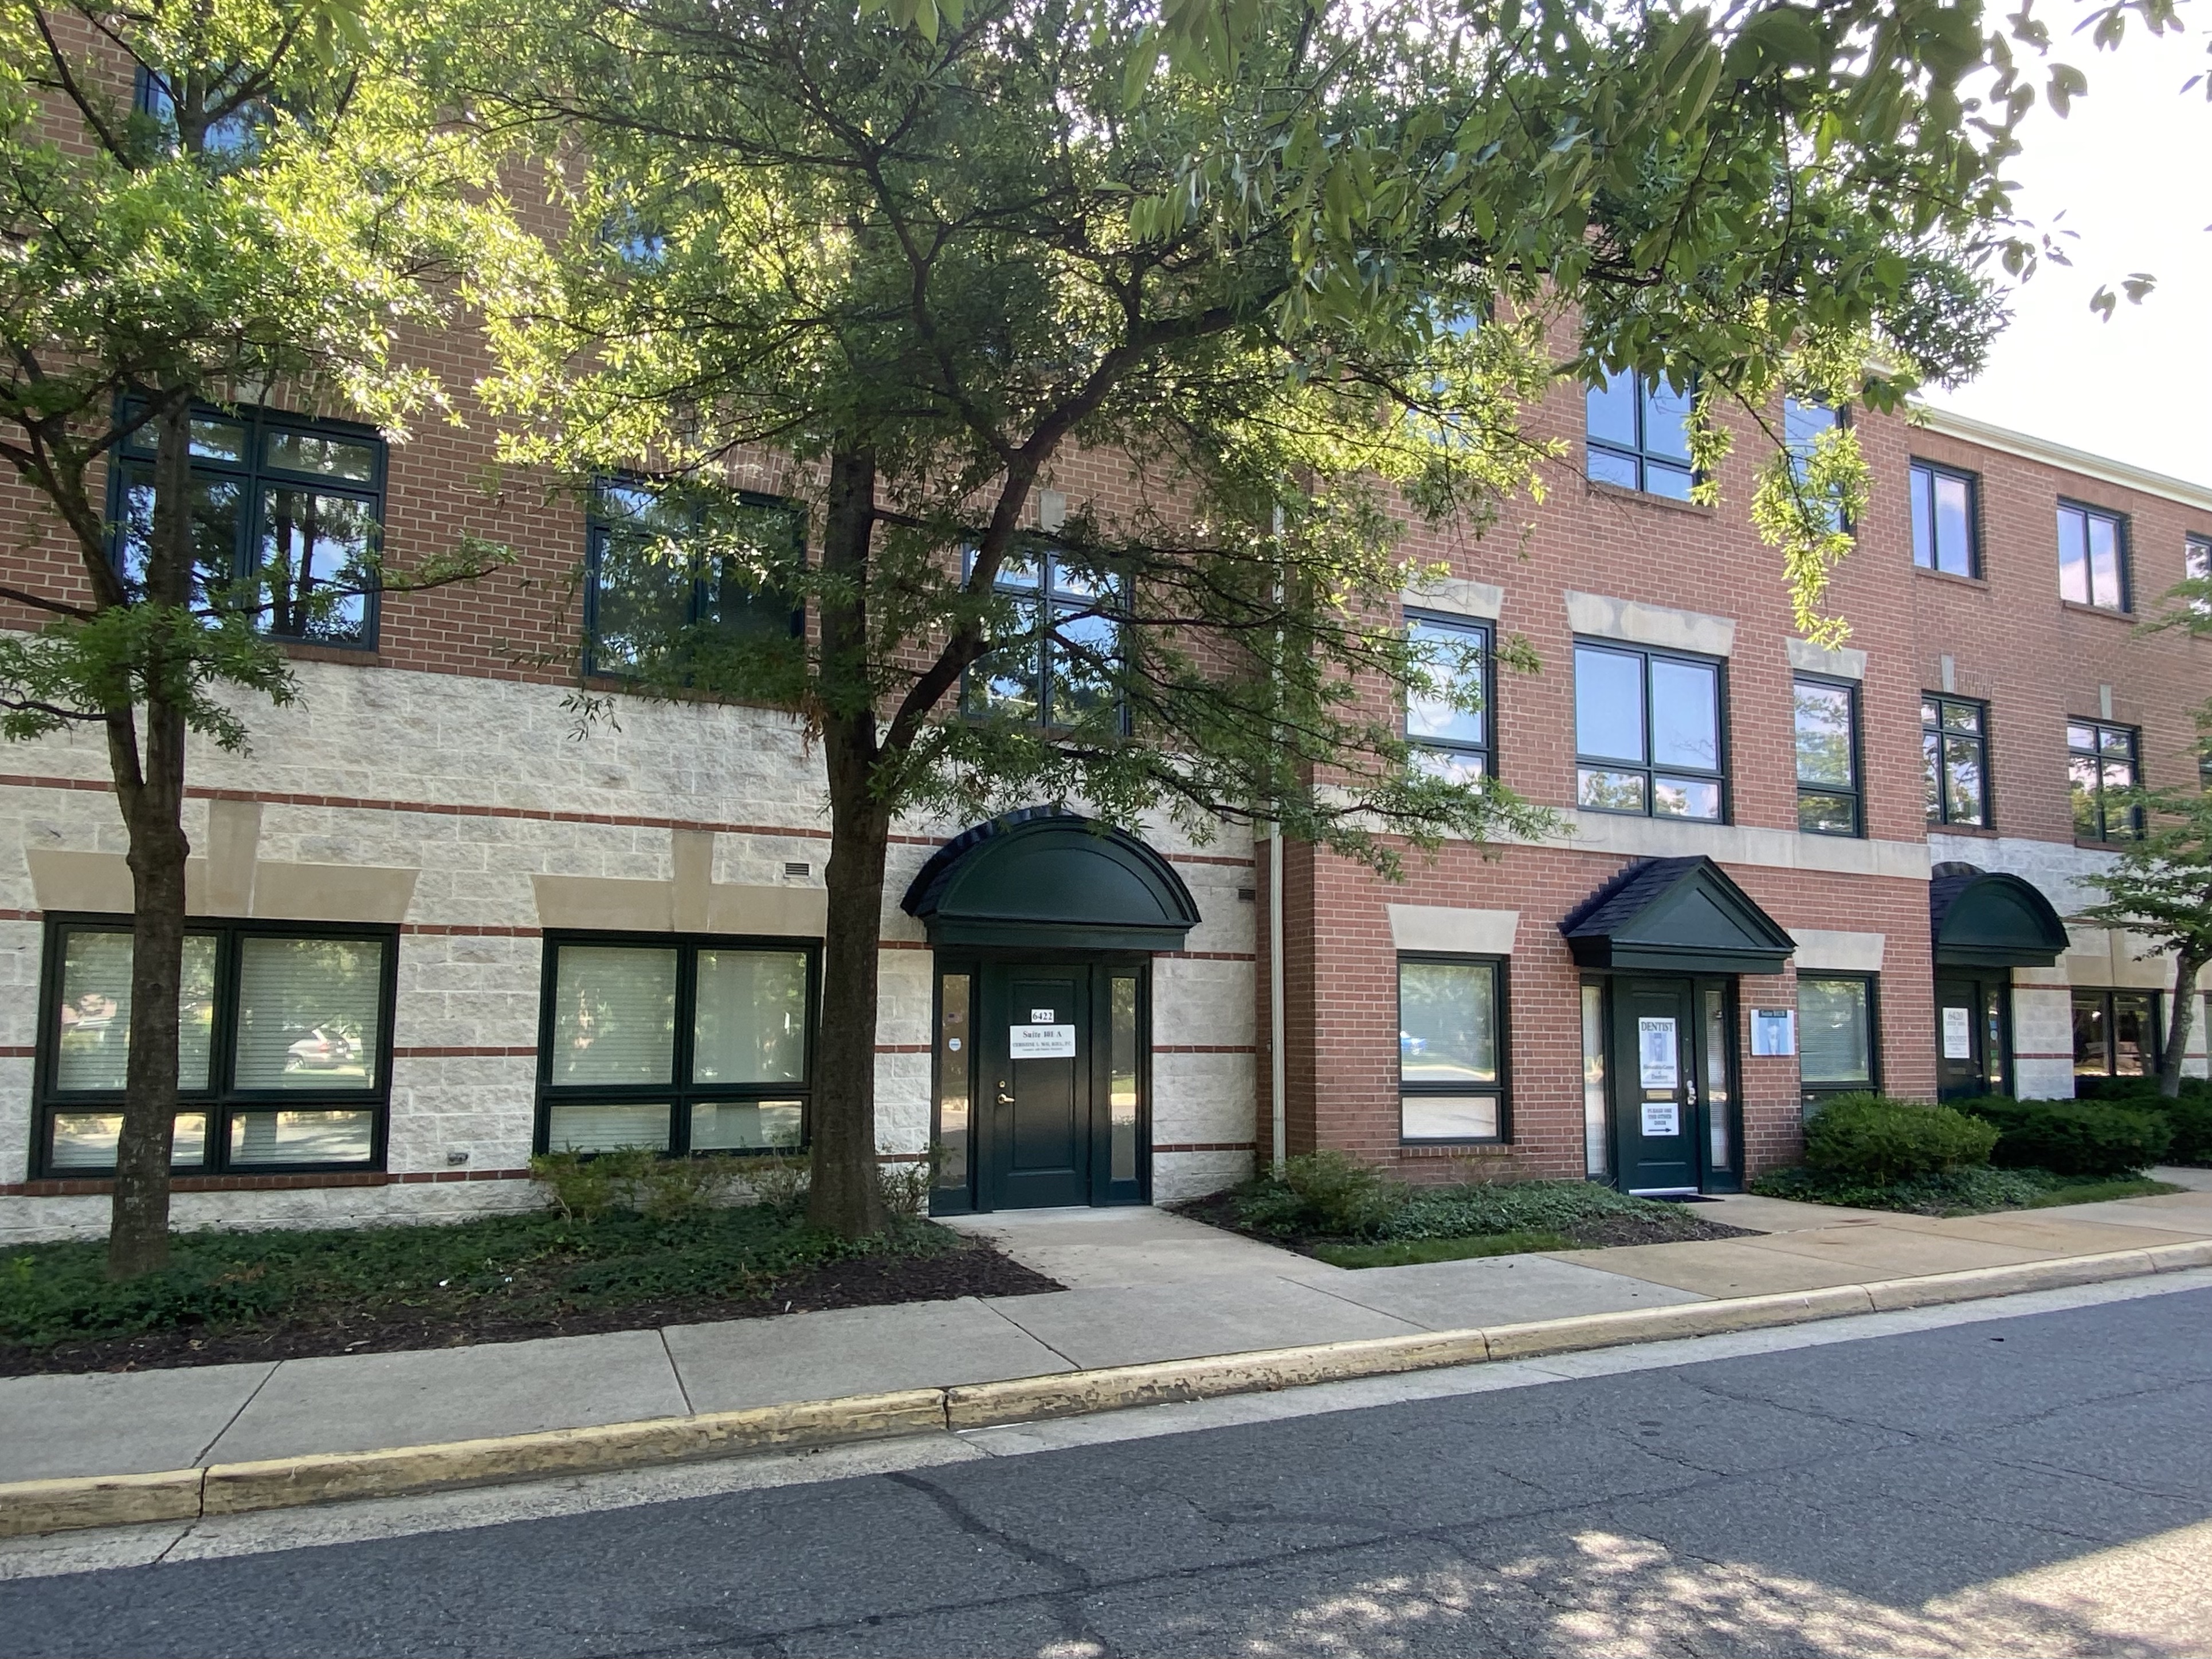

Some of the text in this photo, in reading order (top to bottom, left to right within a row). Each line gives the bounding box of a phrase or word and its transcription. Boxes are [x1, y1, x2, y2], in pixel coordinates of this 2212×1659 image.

[1033, 1012, 1053, 1021] 6422
[1641, 1021, 1673, 1032] DENTIST
[1023, 1030, 1041, 1038] Suite
